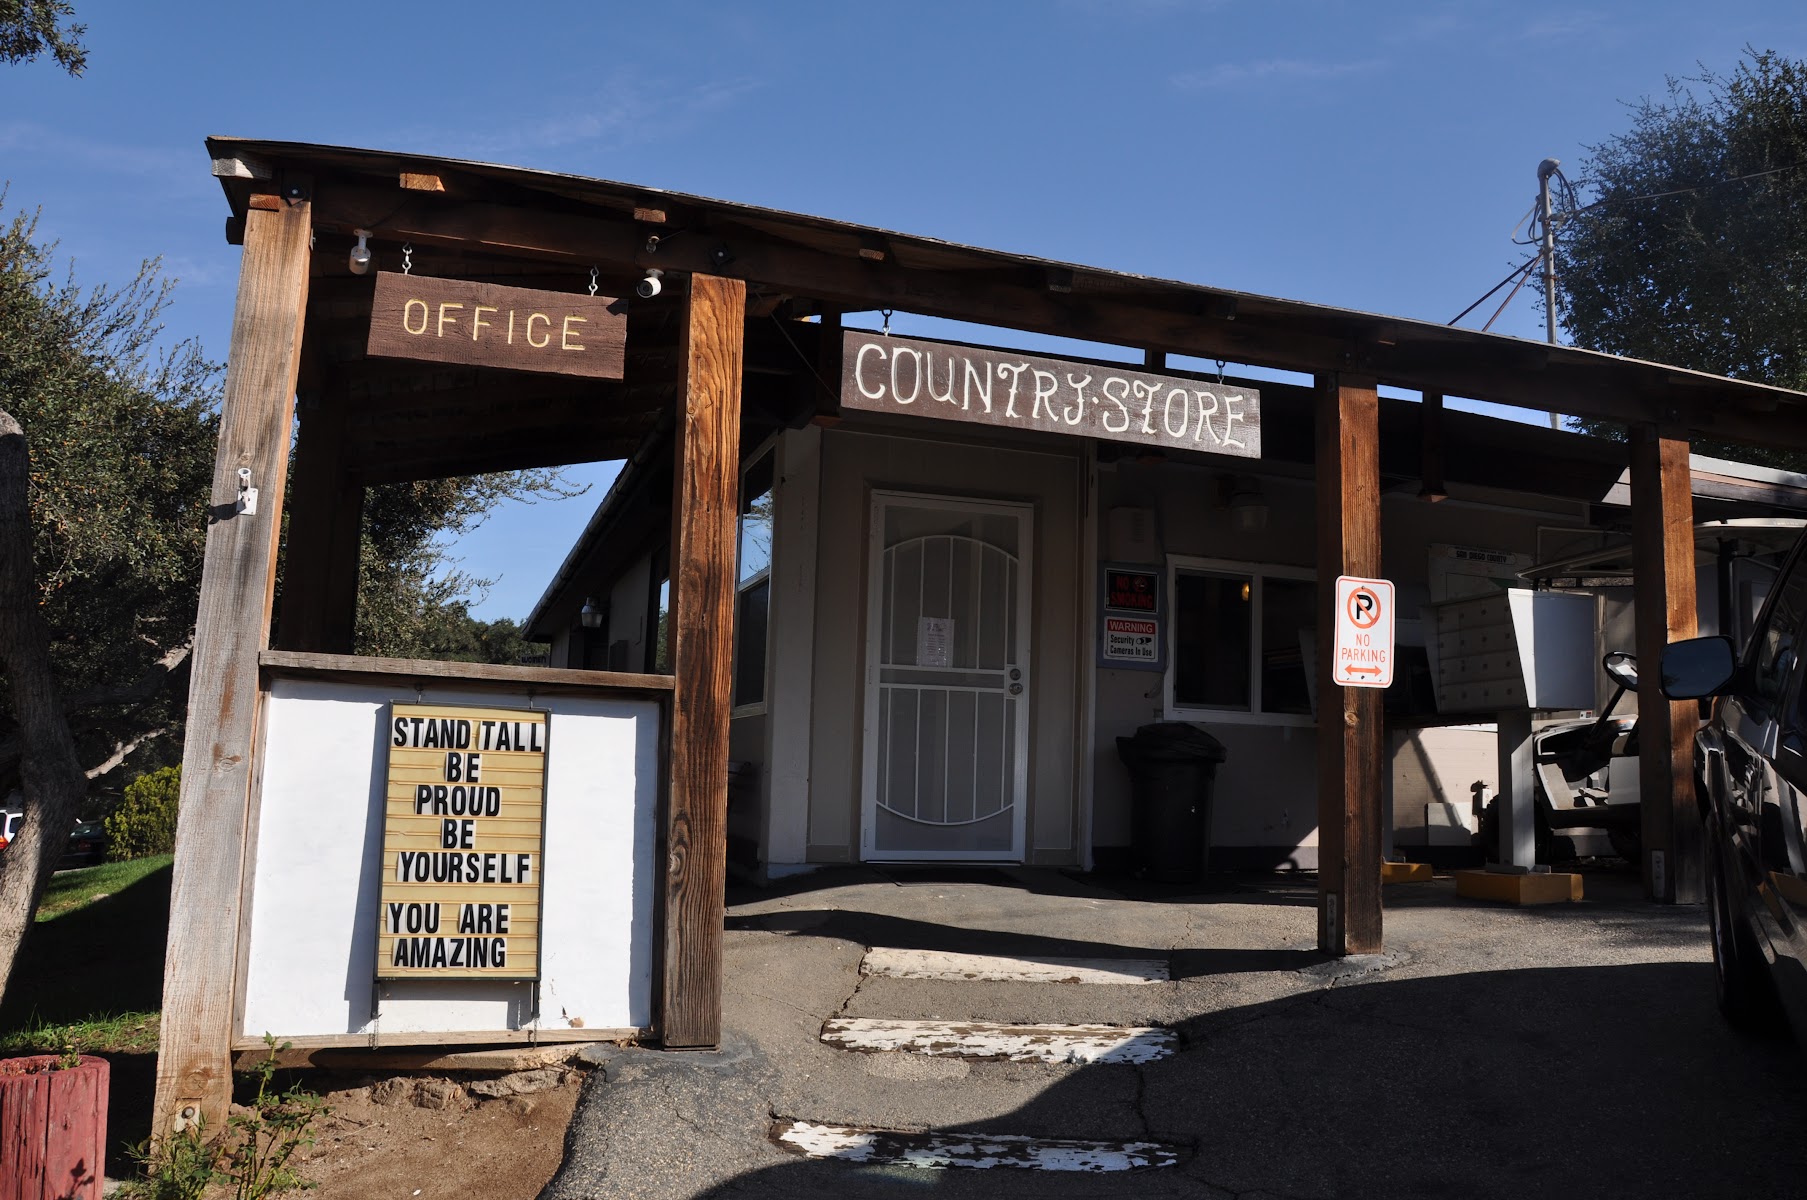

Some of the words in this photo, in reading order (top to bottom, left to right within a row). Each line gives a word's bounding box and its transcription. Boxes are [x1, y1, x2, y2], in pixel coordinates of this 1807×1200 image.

[403, 298, 588, 351] OFFICE
[1469, 552, 1485, 560] DIEGO
[1115, 575, 1130, 591] NO
[1109, 591, 1154, 609] SMOKING
[1109, 620, 1153, 633] WARNING
[1109, 645, 1134, 655] Cameras
[1136, 647, 1141, 655] In
[1142, 648, 1152, 656] Use
[1110, 634, 1135, 646] Security
[1355, 633, 1370, 646] NO
[1341, 648, 1386, 662] PARKING
[393, 716, 471, 750] STAND
[481, 720, 542, 752] TALL
[447, 752, 480, 782] BE
[416, 784, 500, 816] PROUD
[442, 818, 474, 849] BE
[400, 851, 530, 883] YOURSELF
[389, 902, 440, 934] YOU
[459, 903, 509, 934] ARE
[393, 937, 505, 967] AMAZING
